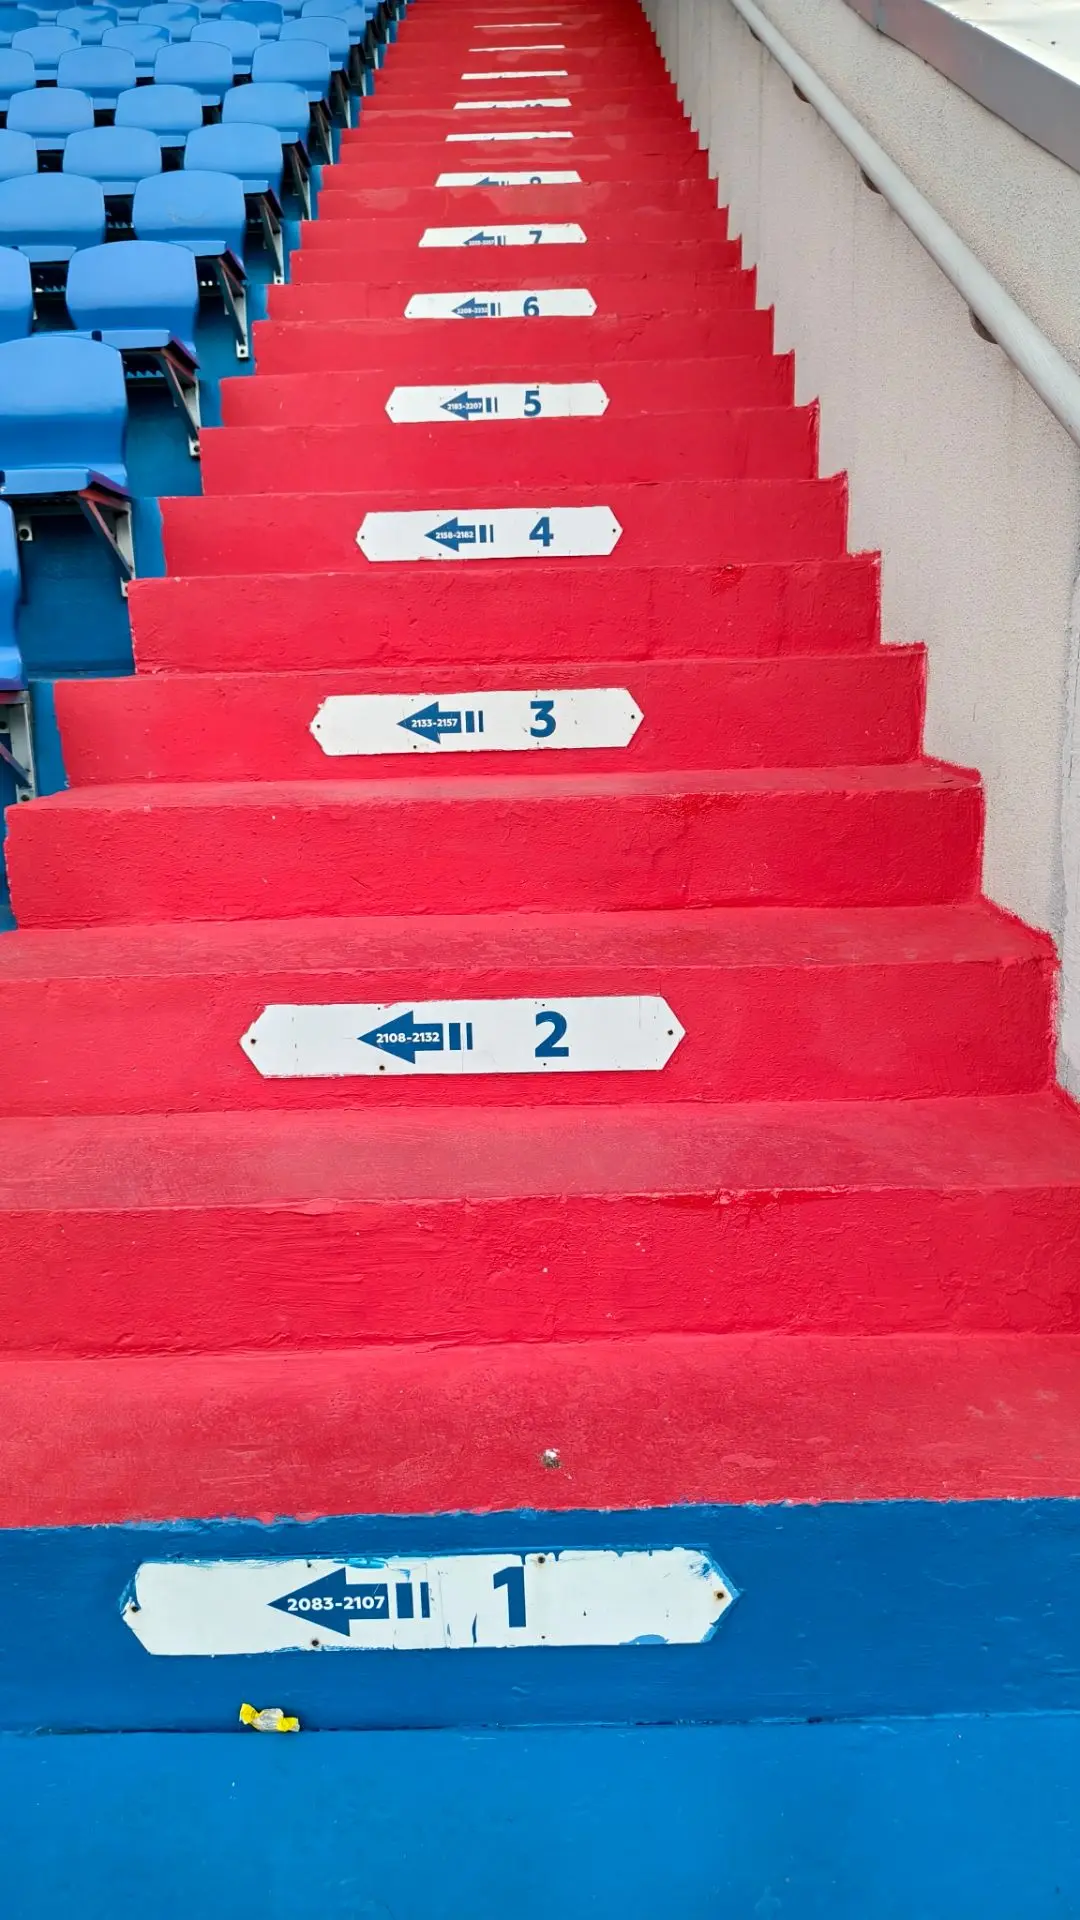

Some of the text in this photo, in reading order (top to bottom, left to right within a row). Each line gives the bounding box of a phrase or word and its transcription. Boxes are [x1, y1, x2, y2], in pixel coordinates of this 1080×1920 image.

[523, 296, 540, 316] 6
[523, 390, 542, 417] 5
[435, 517, 554, 547] 2158-2182 4
[411, 700, 557, 738] 2133-2157 3
[376, 1010, 570, 1058] 2108-2132 2
[287, 1566, 527, 1628] 2083-2107 1
